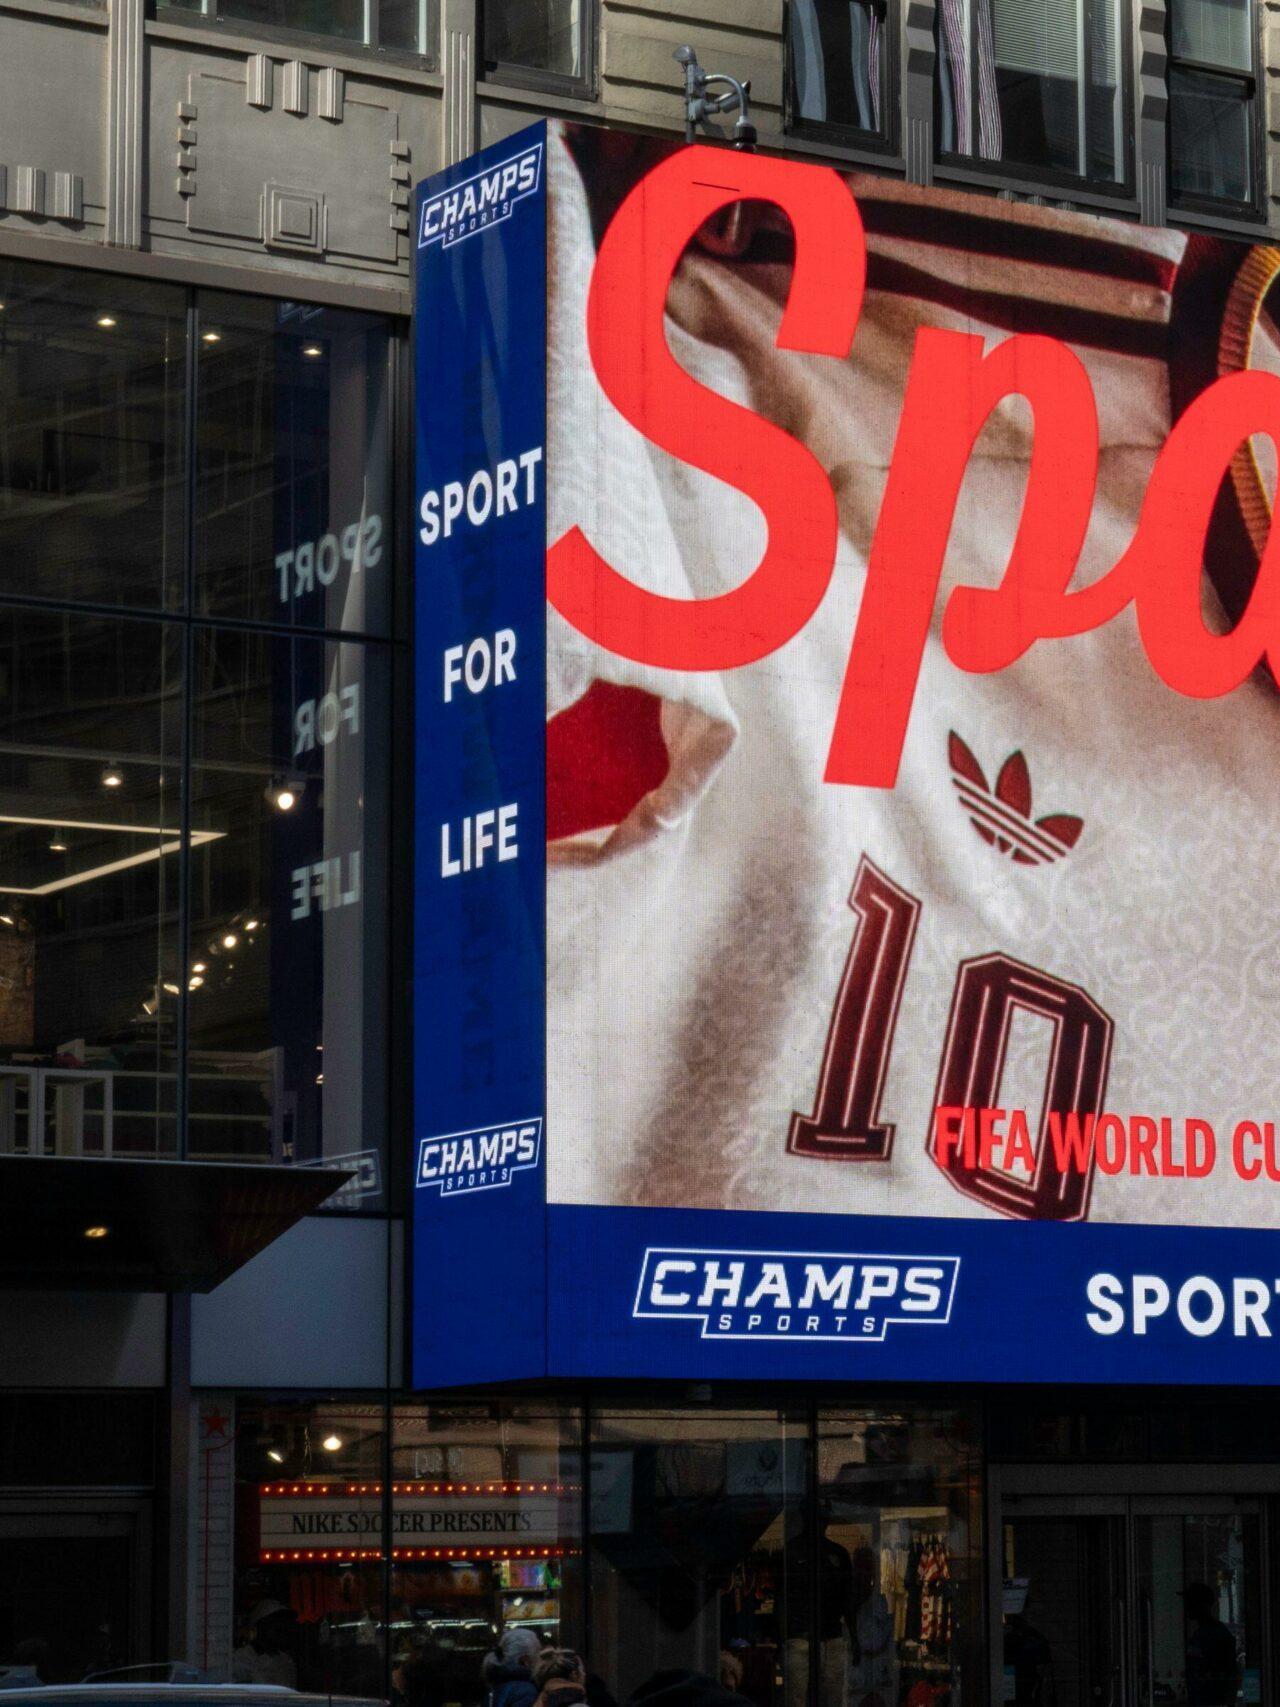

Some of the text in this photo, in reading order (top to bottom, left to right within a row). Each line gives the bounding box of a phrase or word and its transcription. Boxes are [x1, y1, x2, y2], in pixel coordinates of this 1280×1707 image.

[424, 154, 536, 237] CHAMPS
[448, 202, 508, 241] SPORTS
[420, 447, 542, 545] SPORT
[443, 628, 516, 703] FOR
[441, 802, 518, 878] LIFE
[786, 852, 1115, 1223] 10
[422, 1127, 536, 1178] CHAMPS
[935, 1106, 1036, 1172] FIFA
[1050, 1111, 1217, 1179] WORLD
[446, 1168, 508, 1190] SPORTS
[650, 1260, 944, 1312] CHAMPS
[718, 1314, 876, 1332] SPORTS
[293, 1513, 344, 1534] NIKE
[430, 1511, 531, 1532] PRESENTS
